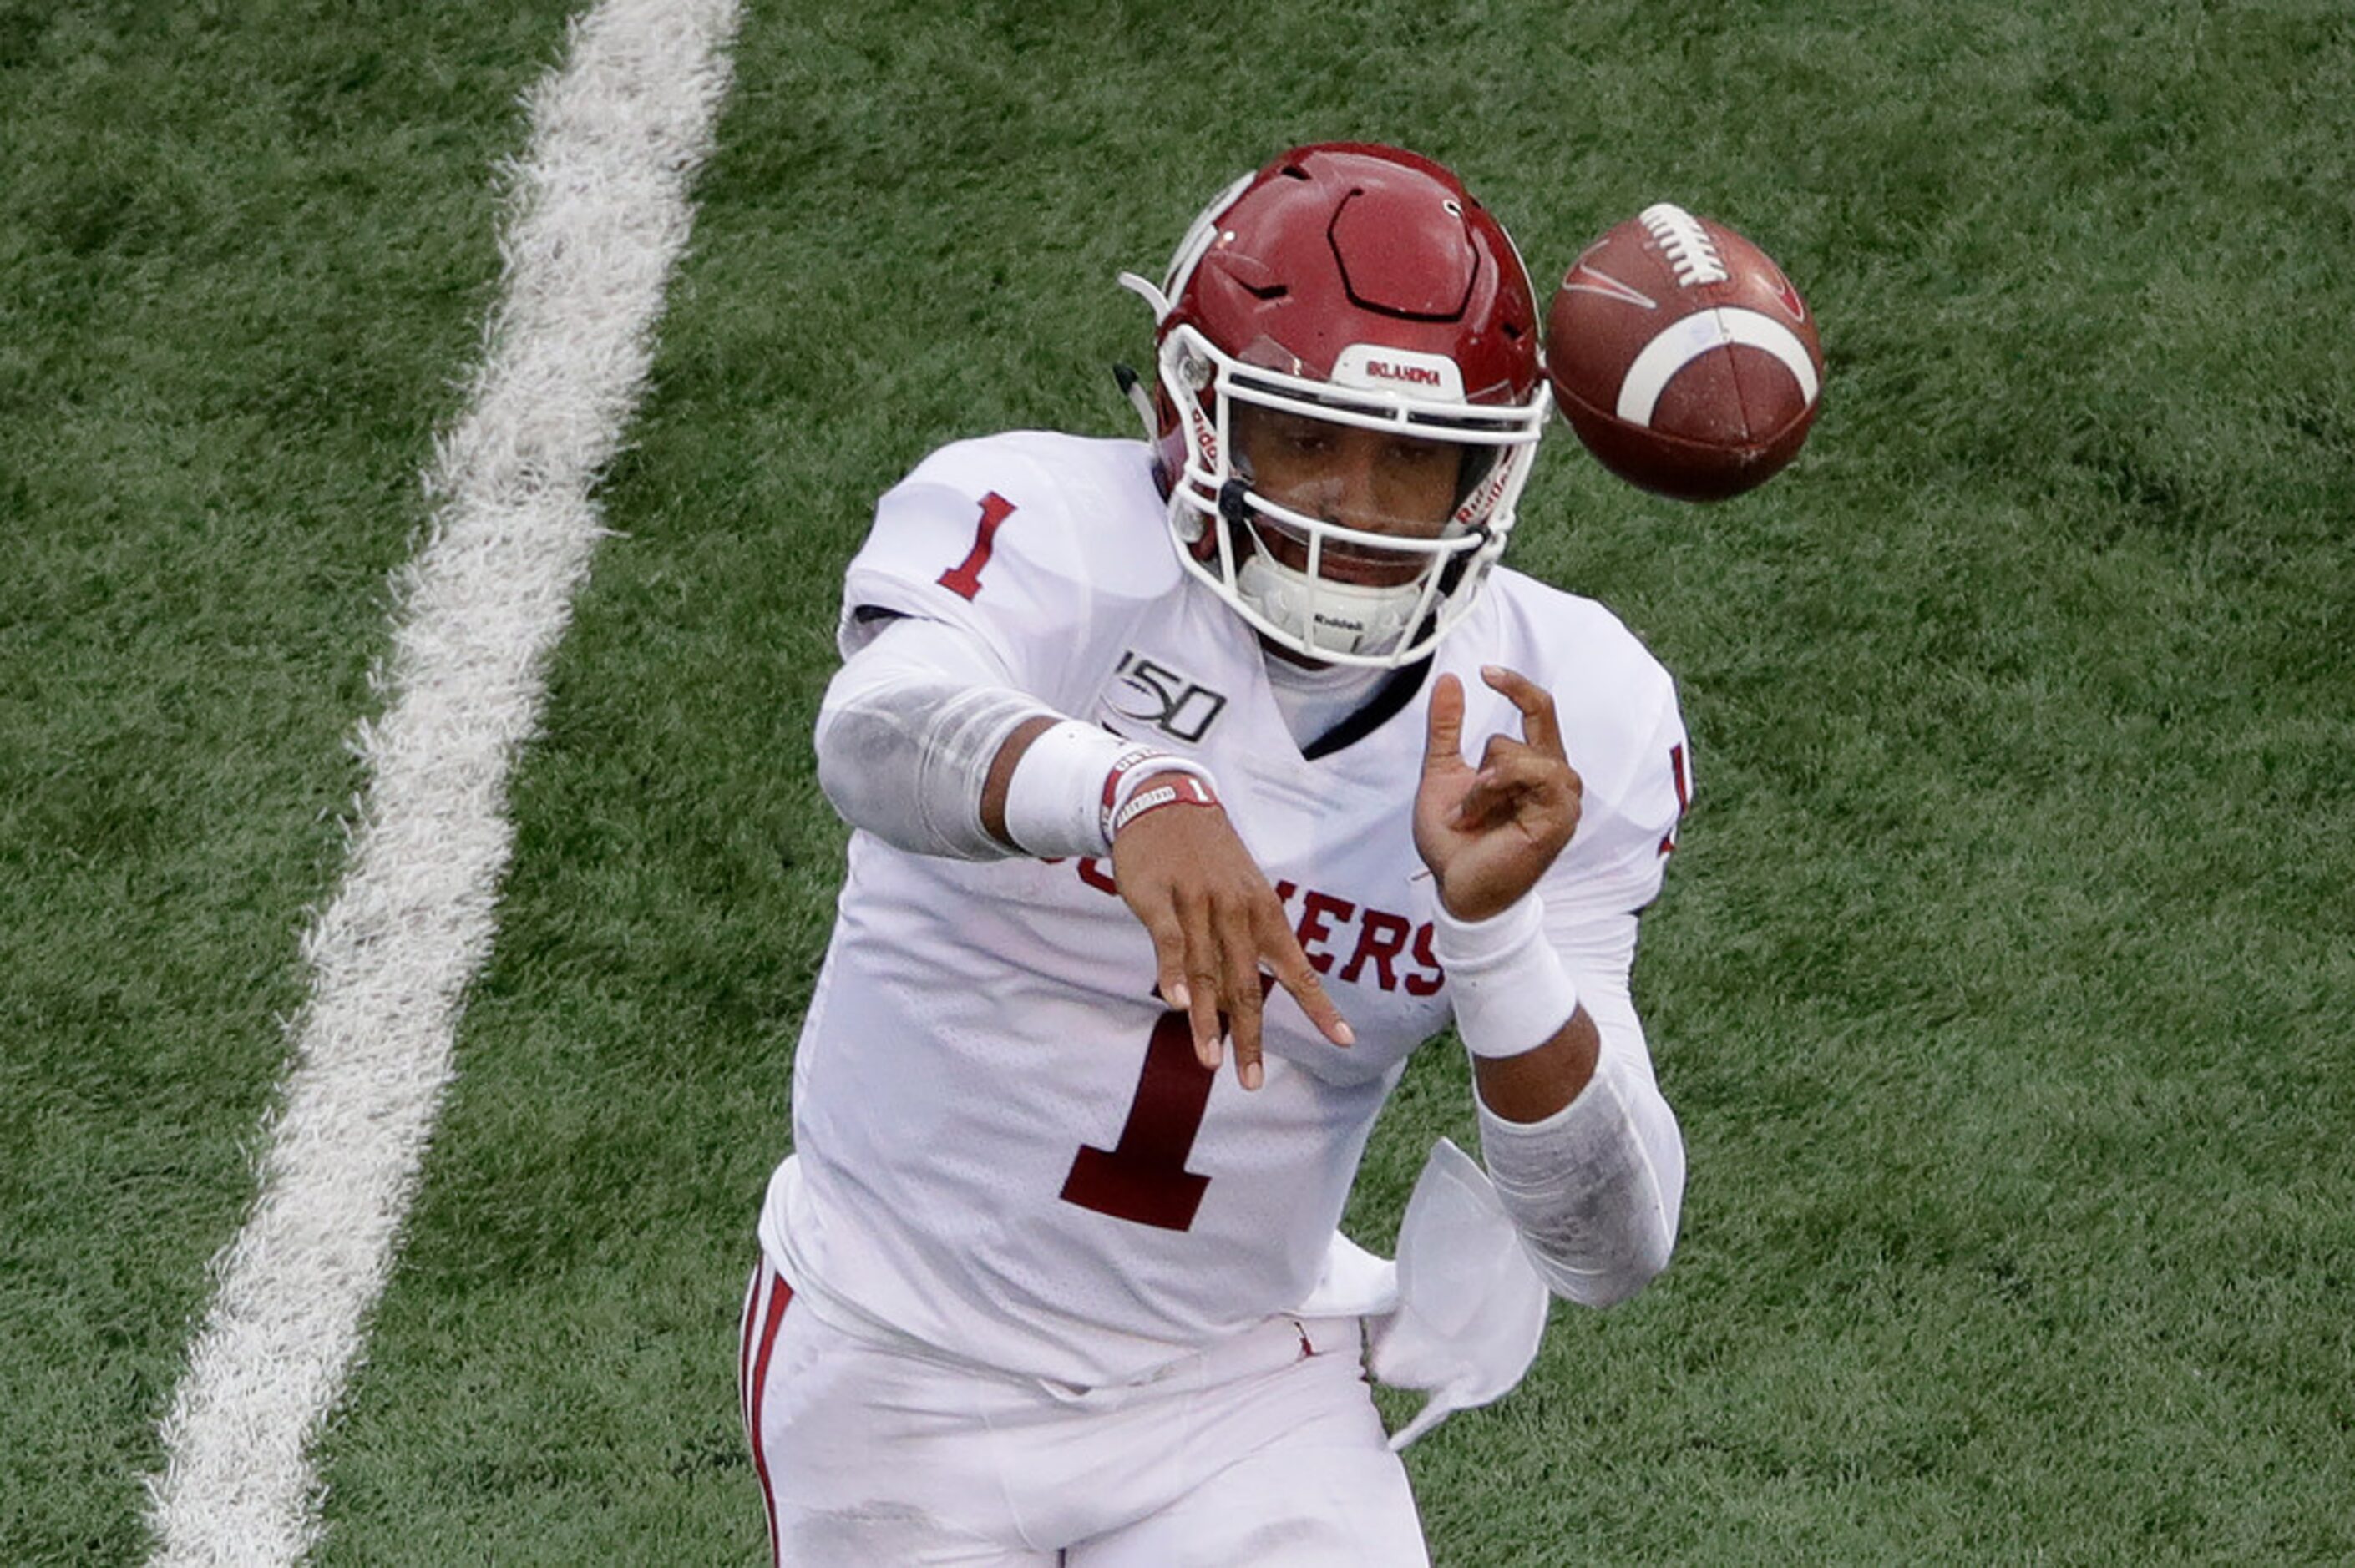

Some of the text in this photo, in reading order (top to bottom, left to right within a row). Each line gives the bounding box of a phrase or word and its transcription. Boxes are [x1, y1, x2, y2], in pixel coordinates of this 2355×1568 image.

[1366, 360, 1441, 387] OKLAHOMA
[935, 490, 1018, 603] 1
[1116, 650, 1228, 743] 150
[1188, 777, 1210, 802] 1
[1060, 970, 1276, 1232] 1
